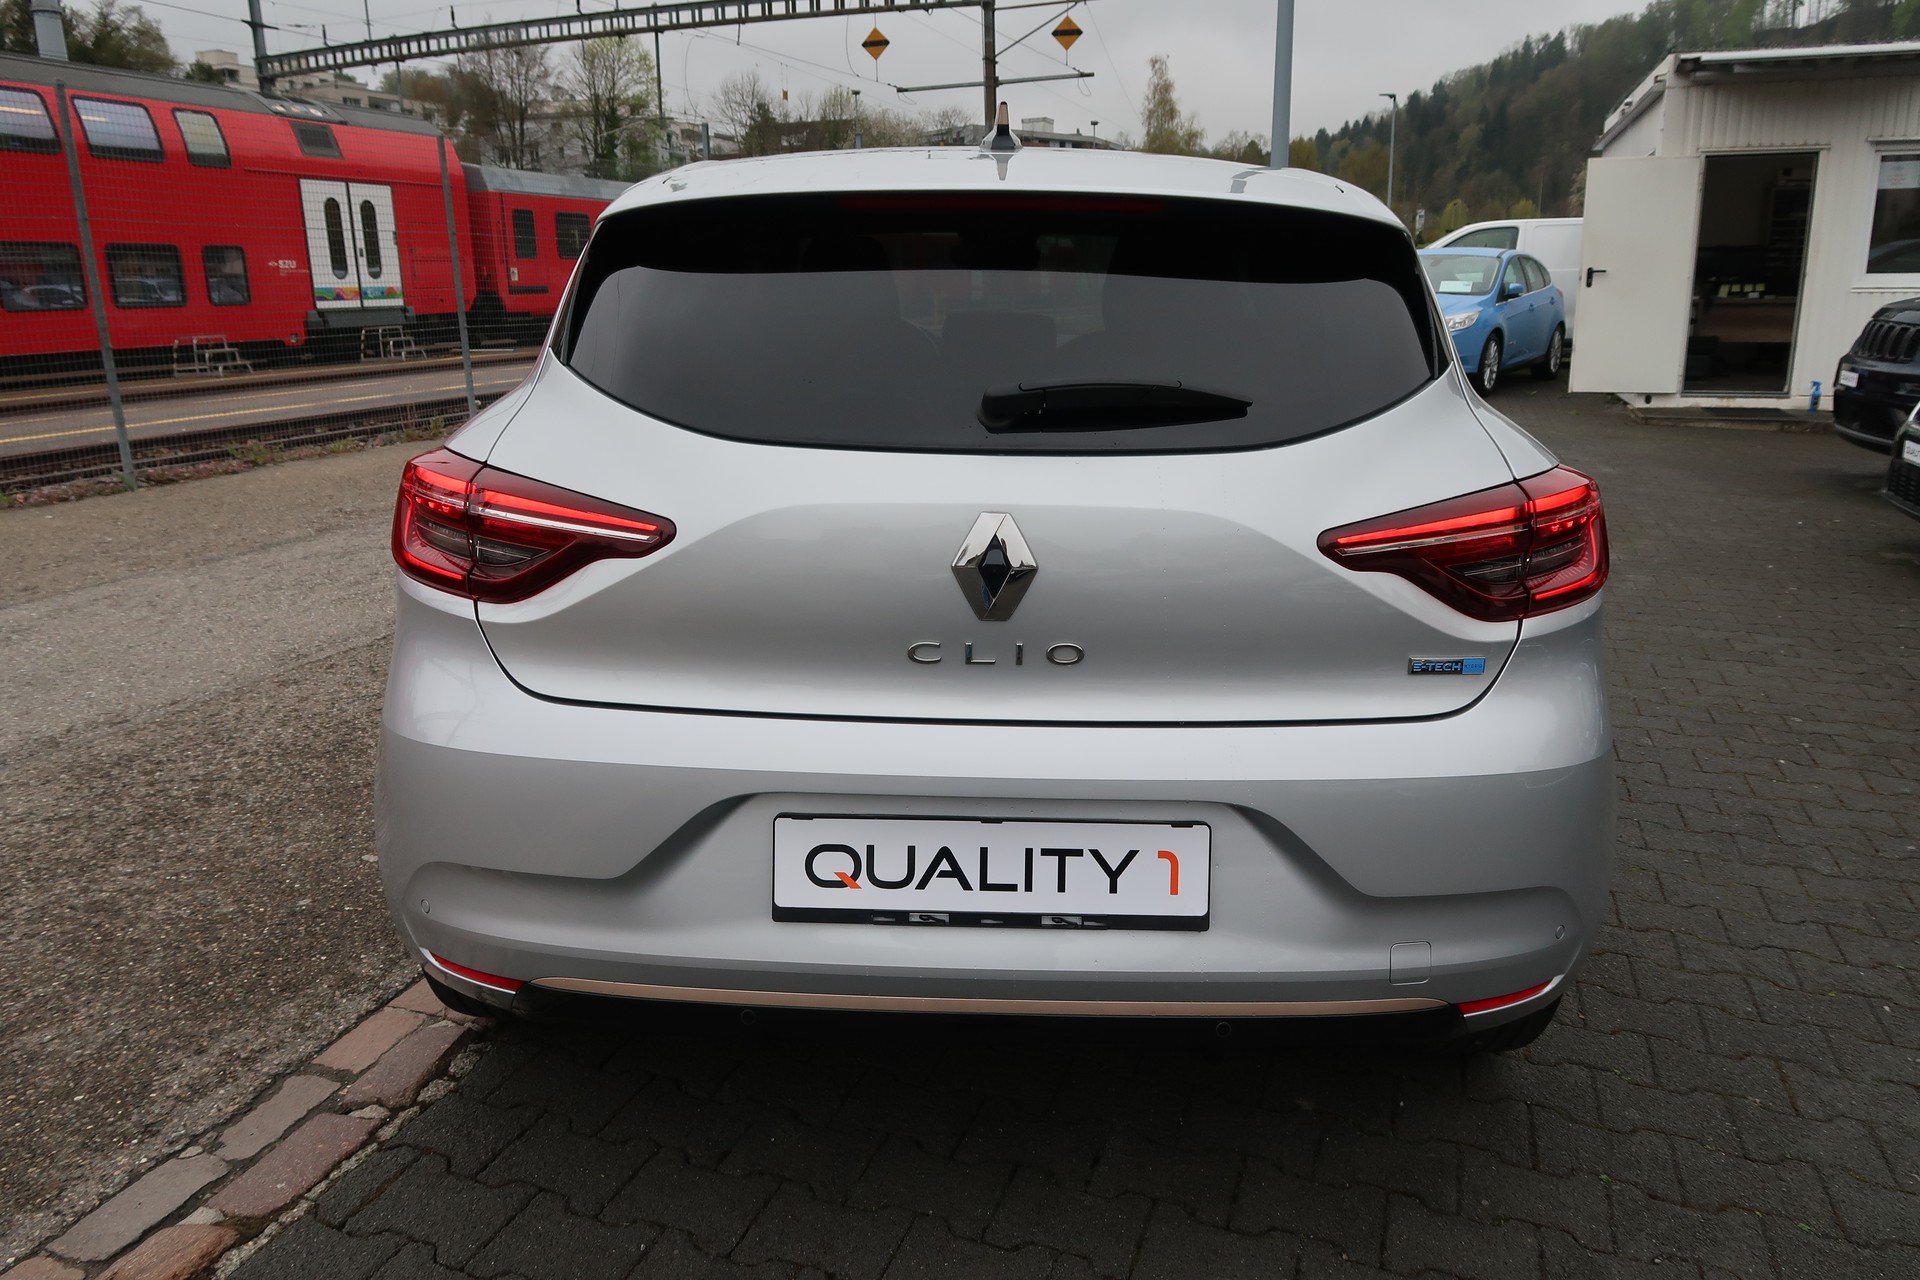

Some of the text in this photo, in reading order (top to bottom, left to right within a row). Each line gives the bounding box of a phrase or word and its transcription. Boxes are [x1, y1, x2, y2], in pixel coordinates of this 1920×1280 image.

[907, 641, 1085, 666] CLIO
[1412, 661, 1462, 672] E-TECH
[804, 843, 1141, 895] QUALITY
